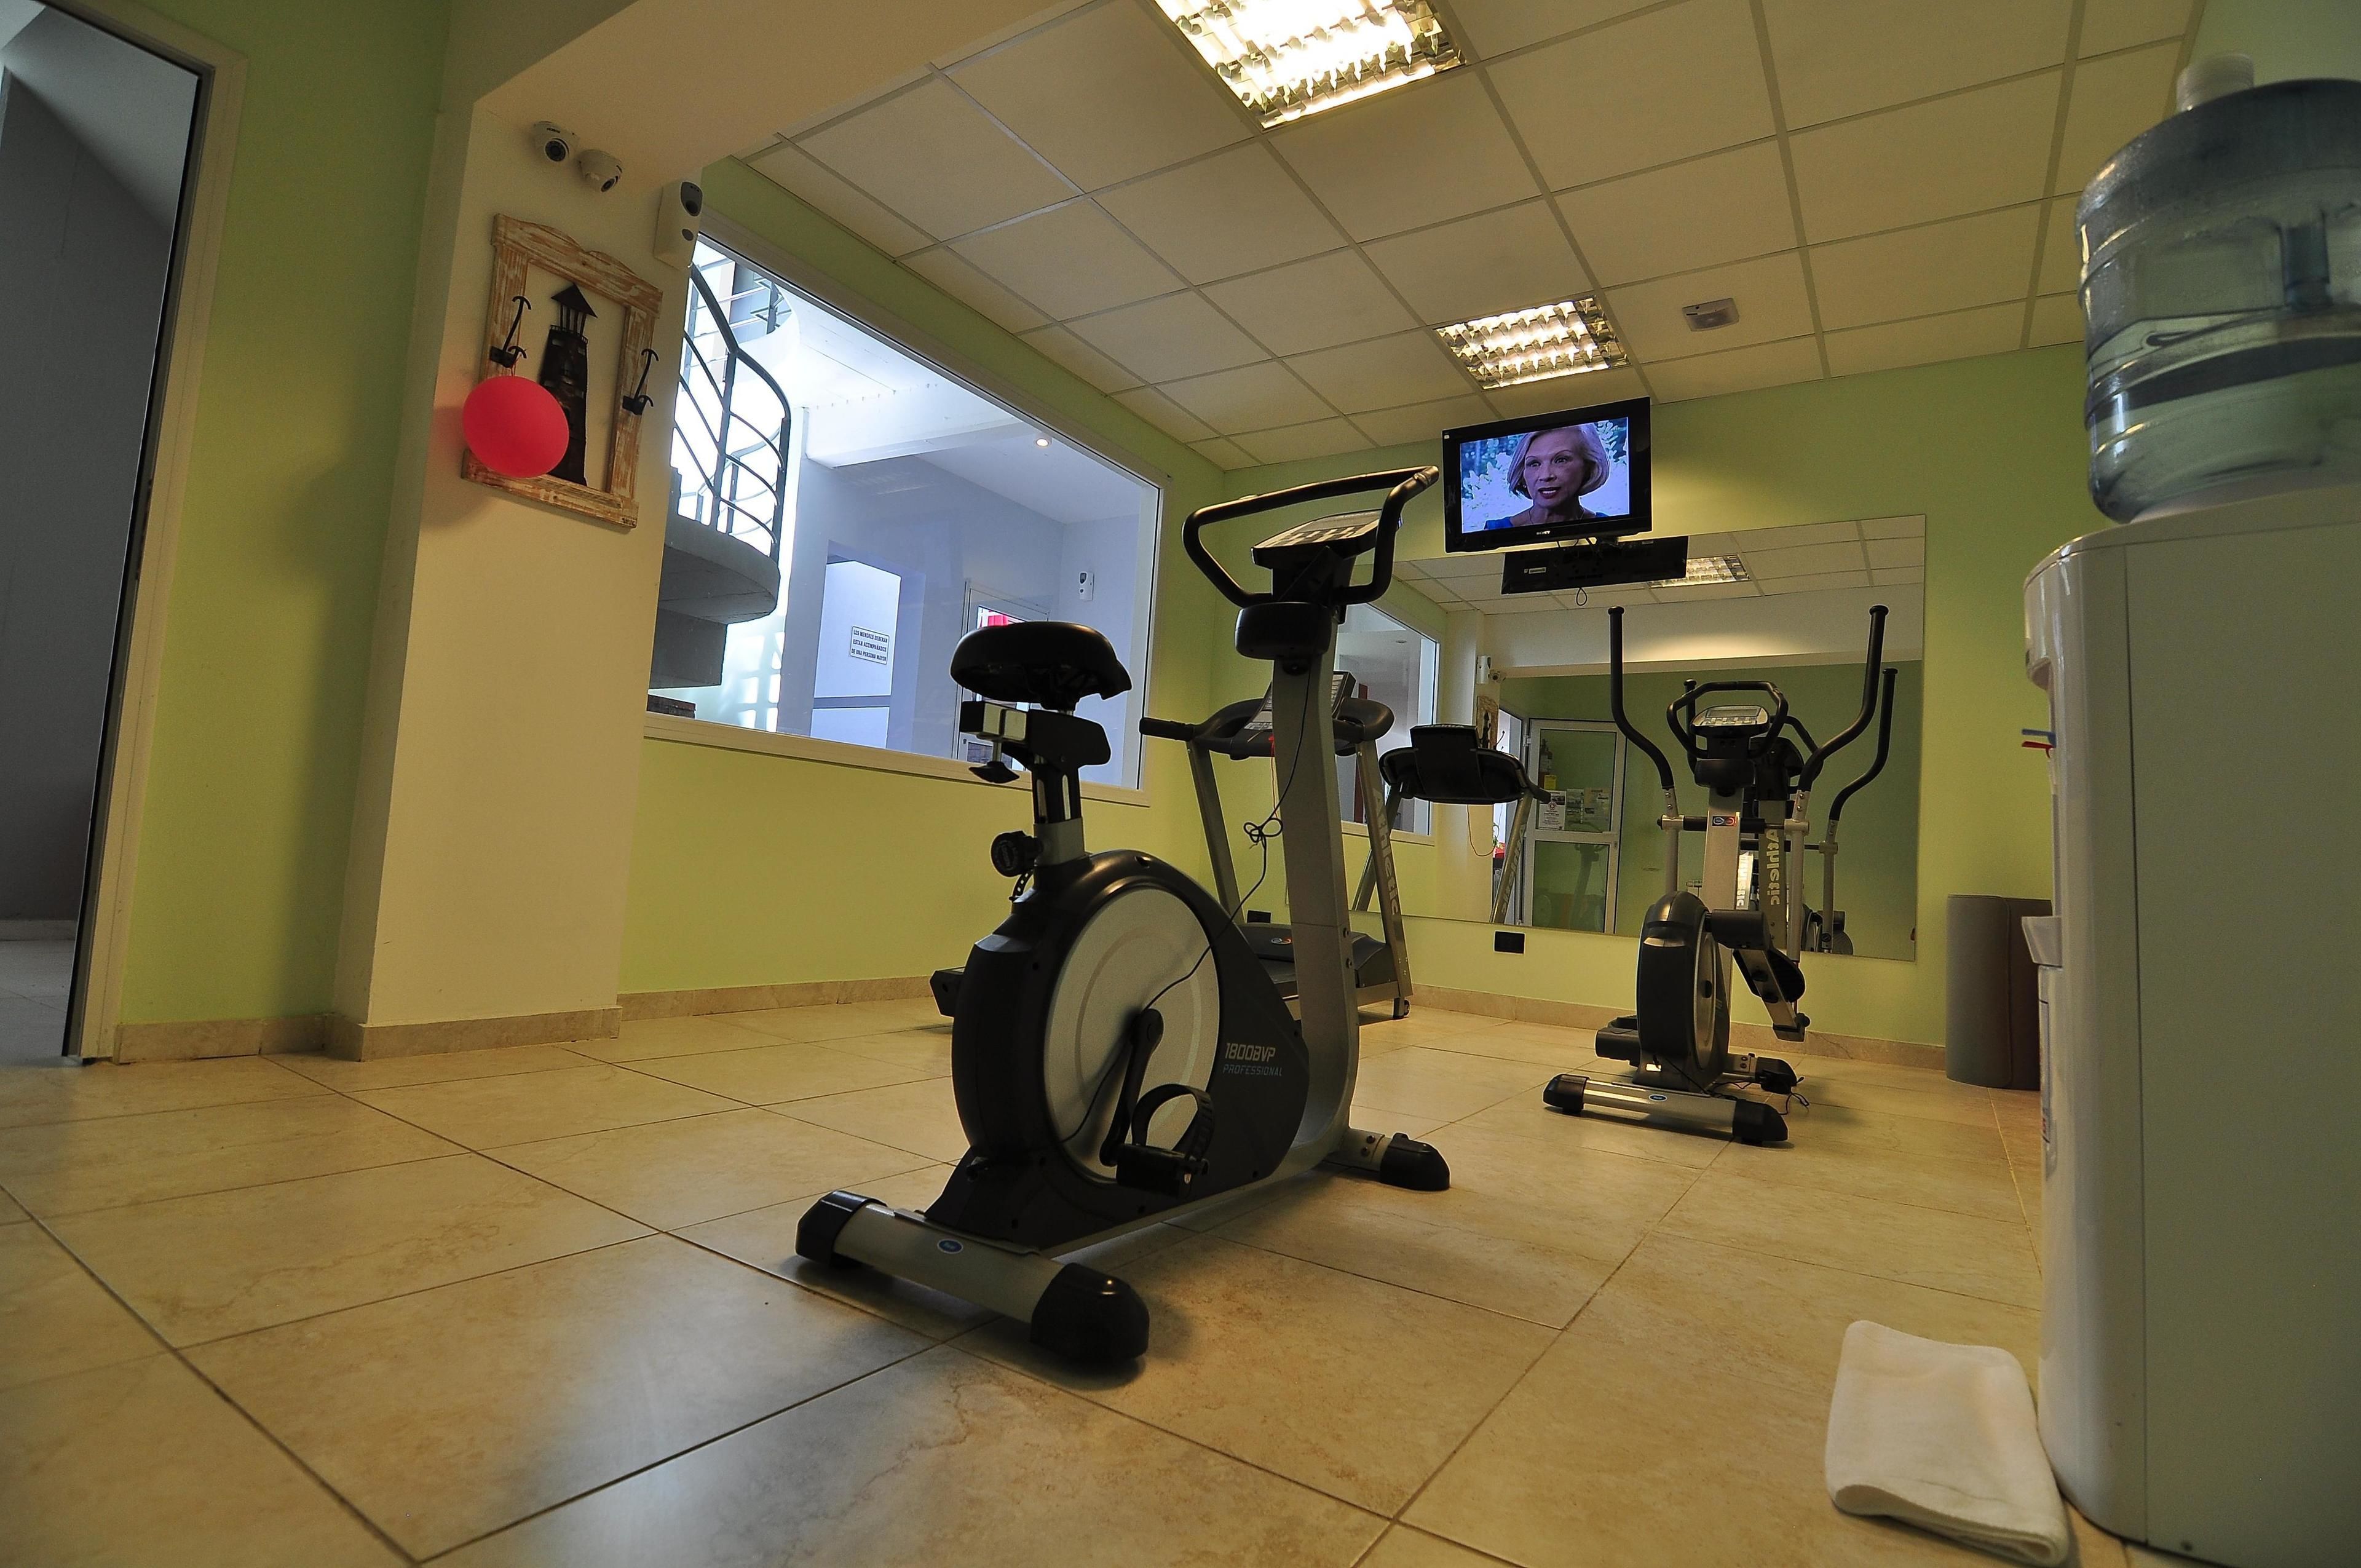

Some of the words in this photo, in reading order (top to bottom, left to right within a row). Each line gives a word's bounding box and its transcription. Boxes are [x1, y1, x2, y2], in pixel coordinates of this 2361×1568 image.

[863, 641, 887, 652] ACOMPAÑADOS
[1372, 788, 1399, 915] Athletic
[1225, 1043, 1276, 1062] 1800BVP
[1223, 1064, 1282, 1076] PROFESSIONAL
